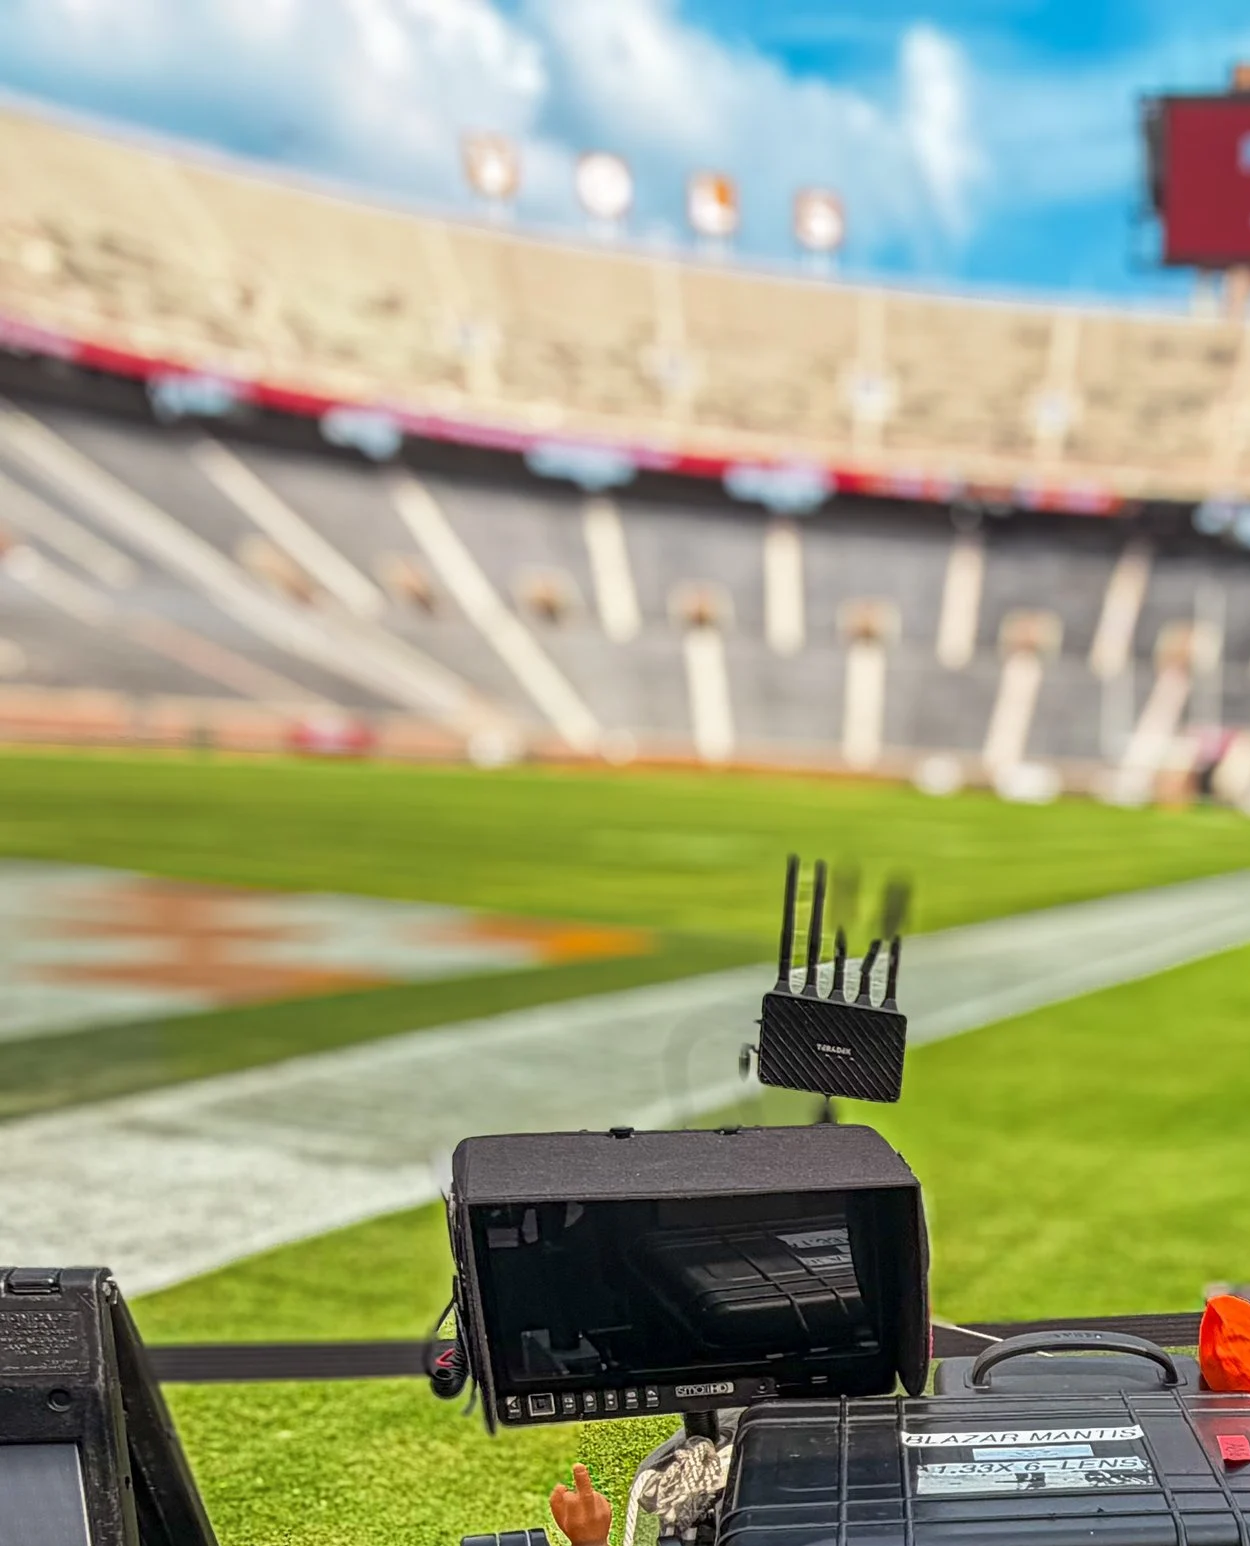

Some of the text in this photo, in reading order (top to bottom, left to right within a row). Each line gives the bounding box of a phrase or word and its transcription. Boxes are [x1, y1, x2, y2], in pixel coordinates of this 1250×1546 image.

[906, 1428, 1138, 1445] BLAZAR MANTIS
[934, 1458, 1139, 1474] 1.33X 6-LENS
